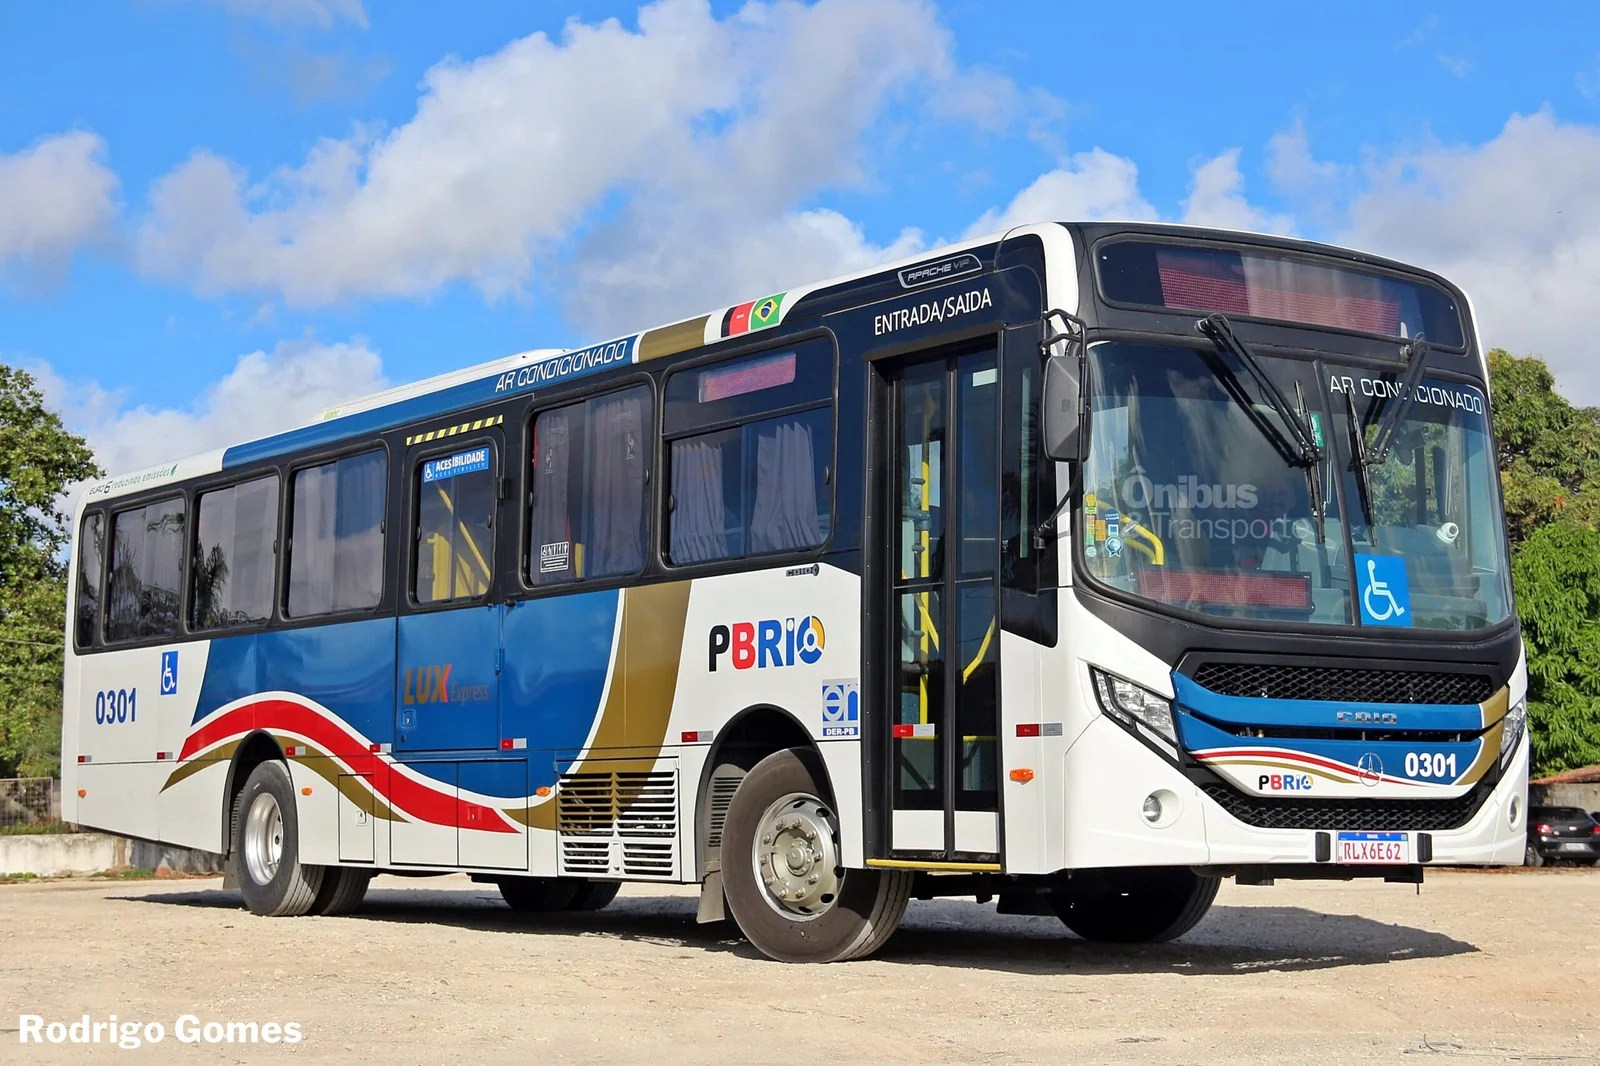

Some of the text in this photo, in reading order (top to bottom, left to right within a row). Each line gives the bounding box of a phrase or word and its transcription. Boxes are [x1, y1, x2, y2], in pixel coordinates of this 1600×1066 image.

[907, 258, 970, 282] APACHE VIP
[874, 288, 992, 336] ENTRADA/SAIDA
[495, 341, 628, 393] AR CONDICIONADO
[1330, 375, 1356, 395] AR
[404, 663, 490, 707] LUX Express
[95, 687, 137, 725] 0301
[826, 727, 855, 736] DER-PB
[1404, 751, 1456, 778] 0301
[1344, 842, 1401, 860] RLX6E62
